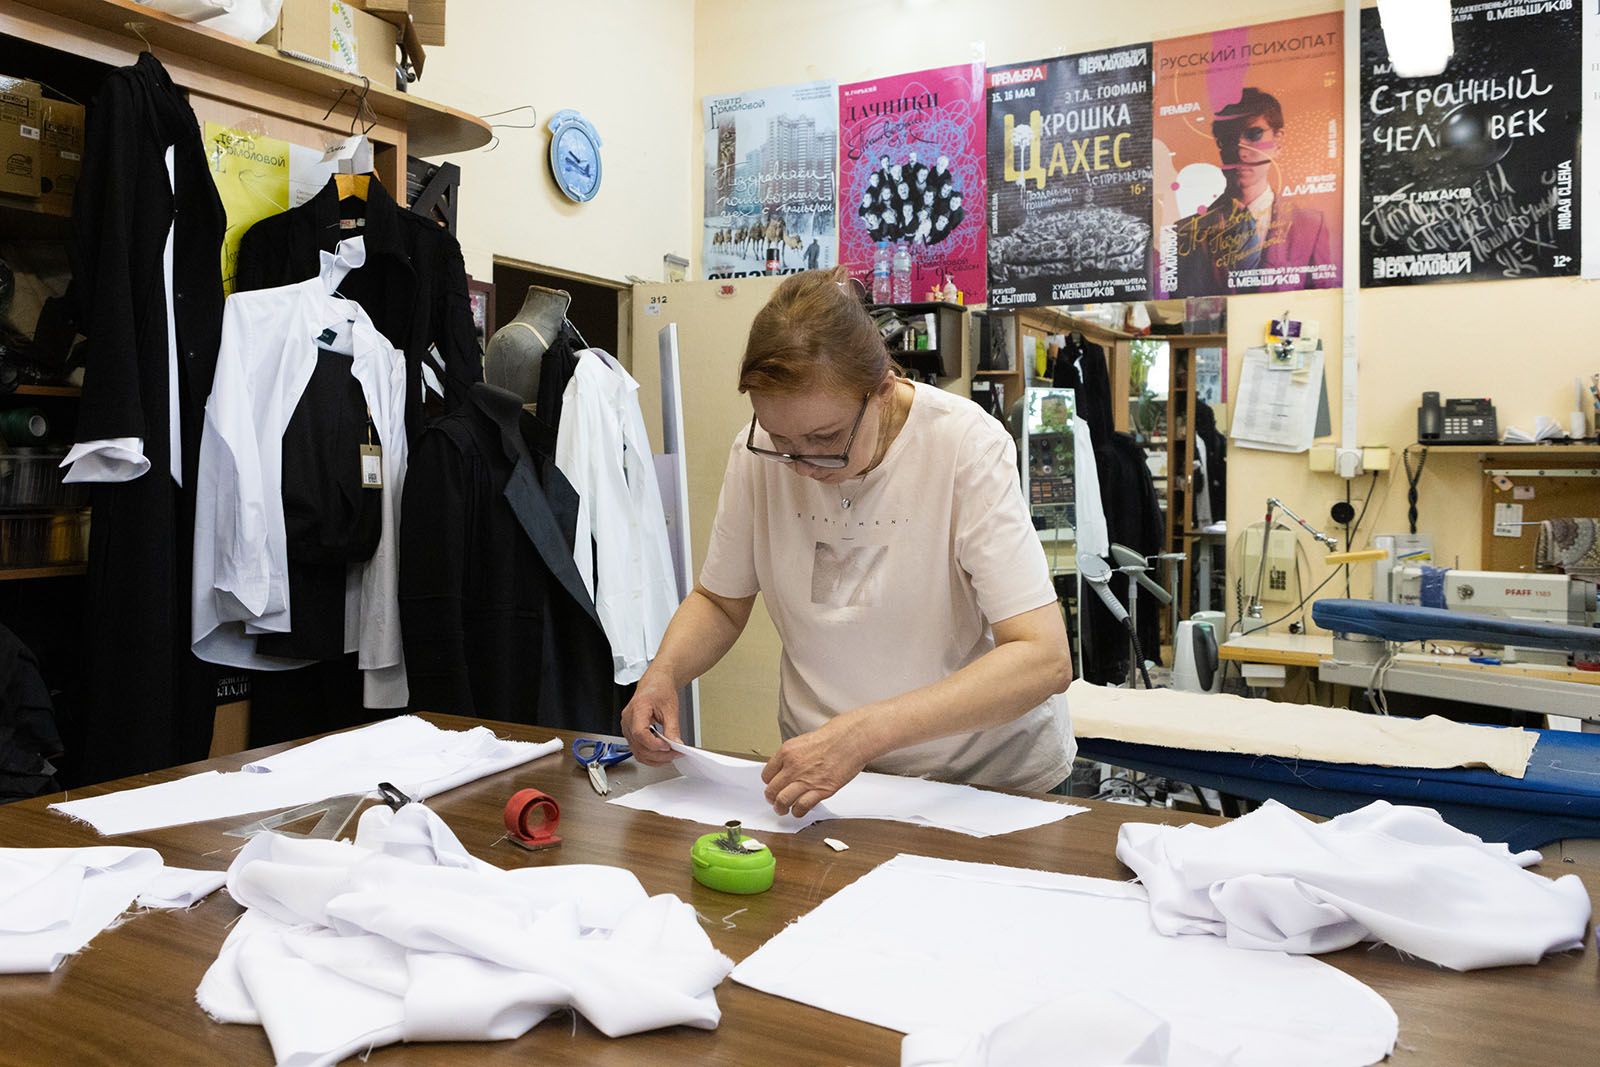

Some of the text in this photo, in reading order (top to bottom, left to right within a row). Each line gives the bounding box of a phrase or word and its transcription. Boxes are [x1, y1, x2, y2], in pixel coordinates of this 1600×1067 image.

[1452, 0, 1513, 14] УДОЖЕСТВЕННЫЙ
[1159, 46, 1236, 70] РУССКИЙ
[1241, 32, 1337, 58] ПСИХОПАТ
[991, 67, 1044, 87] ПРЕМЬЕРА
[1015, 87, 1036, 99] МАЯ
[1097, 80, 1147, 99] ГОФМАН
[845, 93, 939, 123] ДАЧНИКИ
[1159, 102, 1201, 116] ПРЕМЬЕРА
[1040, 103, 1132, 137] КРОШКА
[1004, 110, 1132, 189] ЦАХЕС
[1409, 188, 1472, 203] Г.ЮЖАКОВ
[1557, 160, 1572, 230] НОВАЯ СЦЕНА
[1553, 255, 1572, 267] 12+
[650, 296, 668, 304] 312
[1504, 588, 1532, 596] PFAFF
